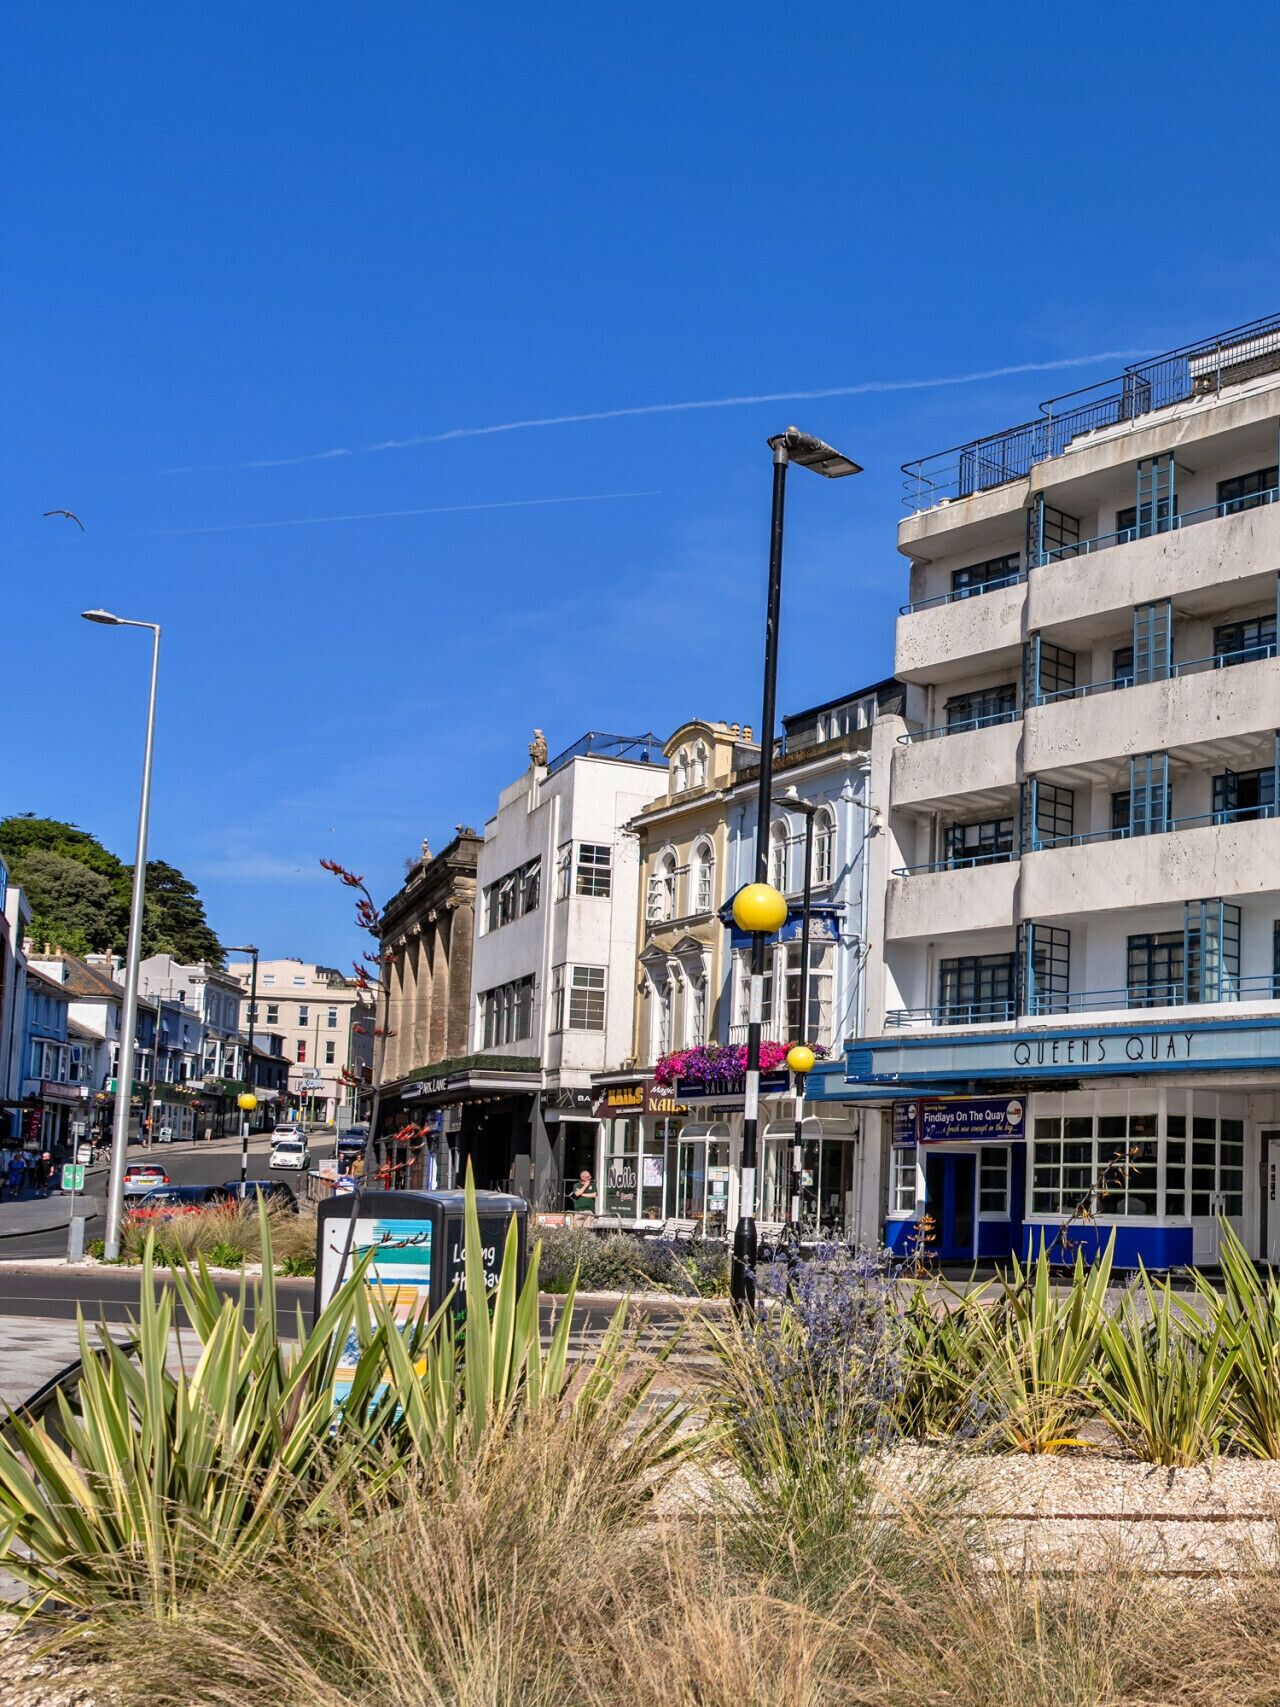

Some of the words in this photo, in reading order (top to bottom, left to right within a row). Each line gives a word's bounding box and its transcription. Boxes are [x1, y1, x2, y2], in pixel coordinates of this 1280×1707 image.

[1013, 1038, 1106, 1066] QUEENS
[1125, 1034, 1194, 1061] QUAY
[432, 1078, 447, 1092] LANE
[650, 1086, 675, 1097] Magic
[607, 1087, 644, 1107] NAILS
[648, 1097, 687, 1112] NAILS
[924, 1112, 955, 1124] Findlays
[956, 1111, 967, 1121] On
[969, 1110, 983, 1121] The
[985, 1109, 1006, 1122] Quay
[608, 1166, 637, 1188] Nails
[453, 1243, 495, 1266] Long
